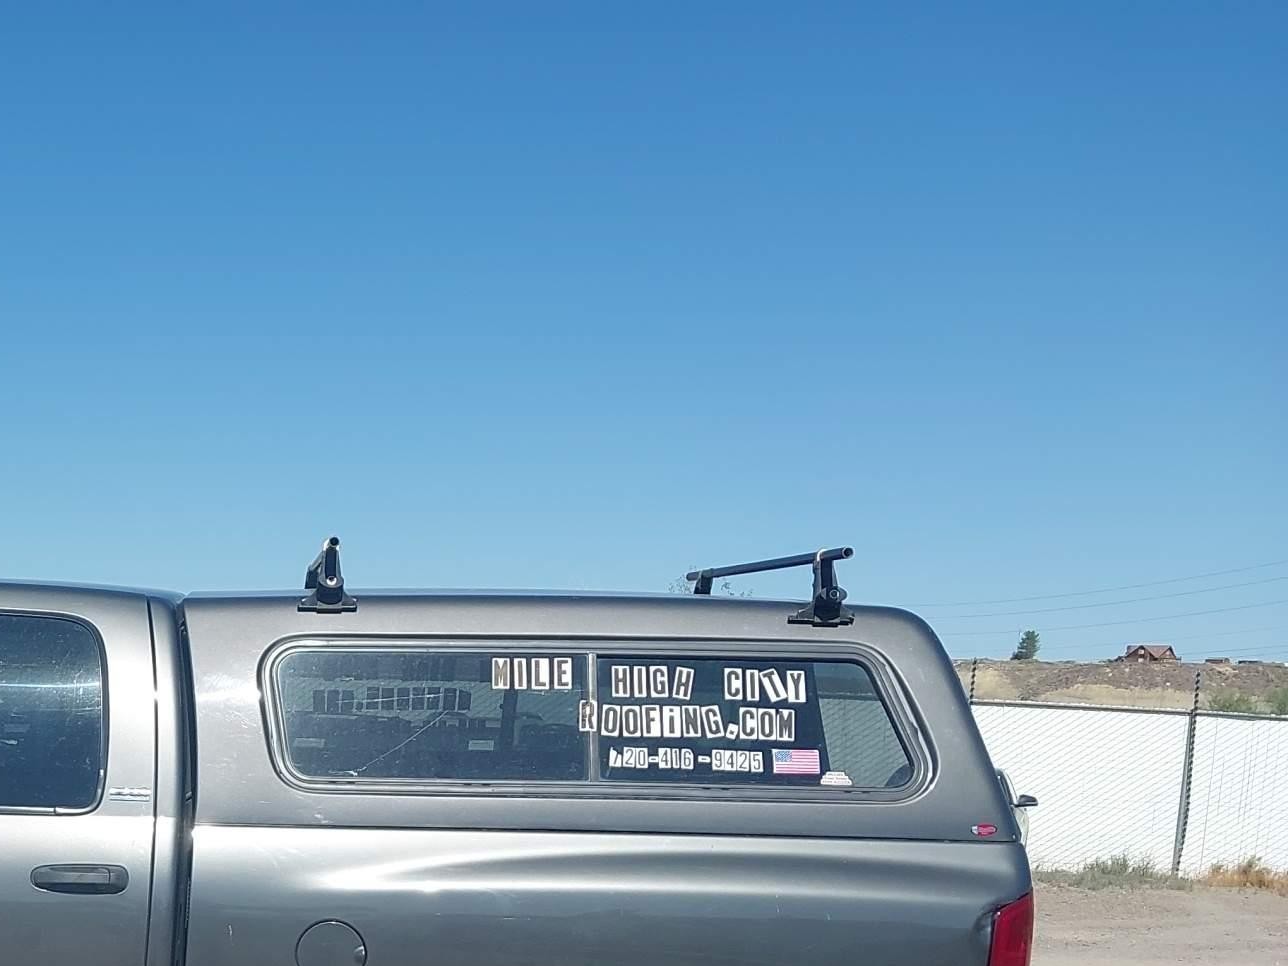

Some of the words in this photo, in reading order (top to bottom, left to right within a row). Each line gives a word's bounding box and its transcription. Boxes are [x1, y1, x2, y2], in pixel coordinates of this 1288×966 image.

[493, 659, 570, 688] MILE
[613, 667, 693, 698] HIGH
[725, 669, 805, 701] CITY
